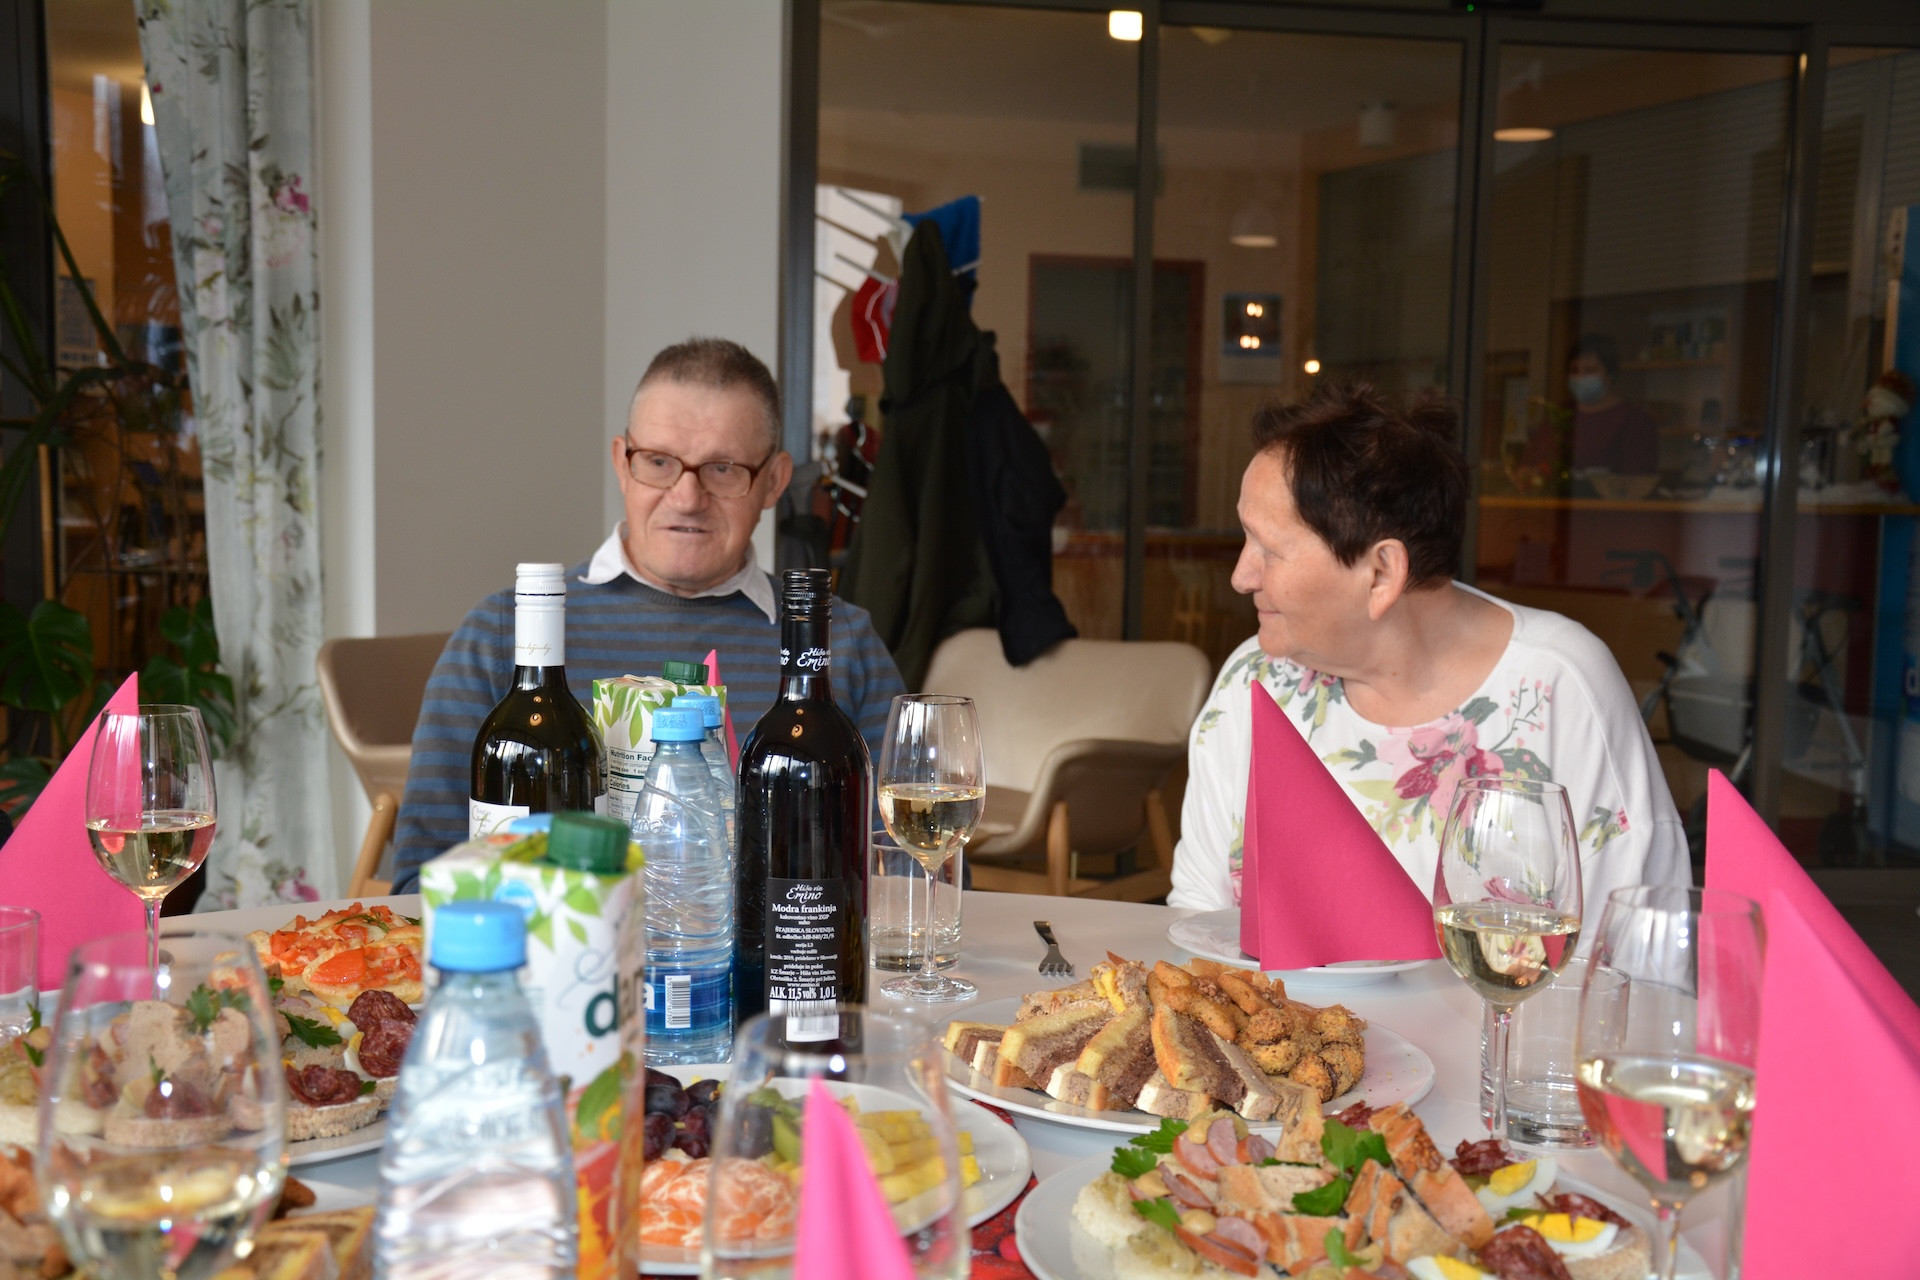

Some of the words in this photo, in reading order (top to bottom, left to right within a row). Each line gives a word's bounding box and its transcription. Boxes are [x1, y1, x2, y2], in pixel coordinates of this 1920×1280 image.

[611, 750, 635, 760] Nutrition
[610, 778, 630, 790] Calories
[786, 888, 824, 904] Emino
[772, 903, 799, 913] Modra
[801, 904, 837, 915] frankinja
[775, 925, 805, 934] ŠTAJERSKA
[805, 926, 835, 934] SLOVENIJA
[770, 985, 787, 999] ALK.
[788, 987, 802, 1000] 11,5
